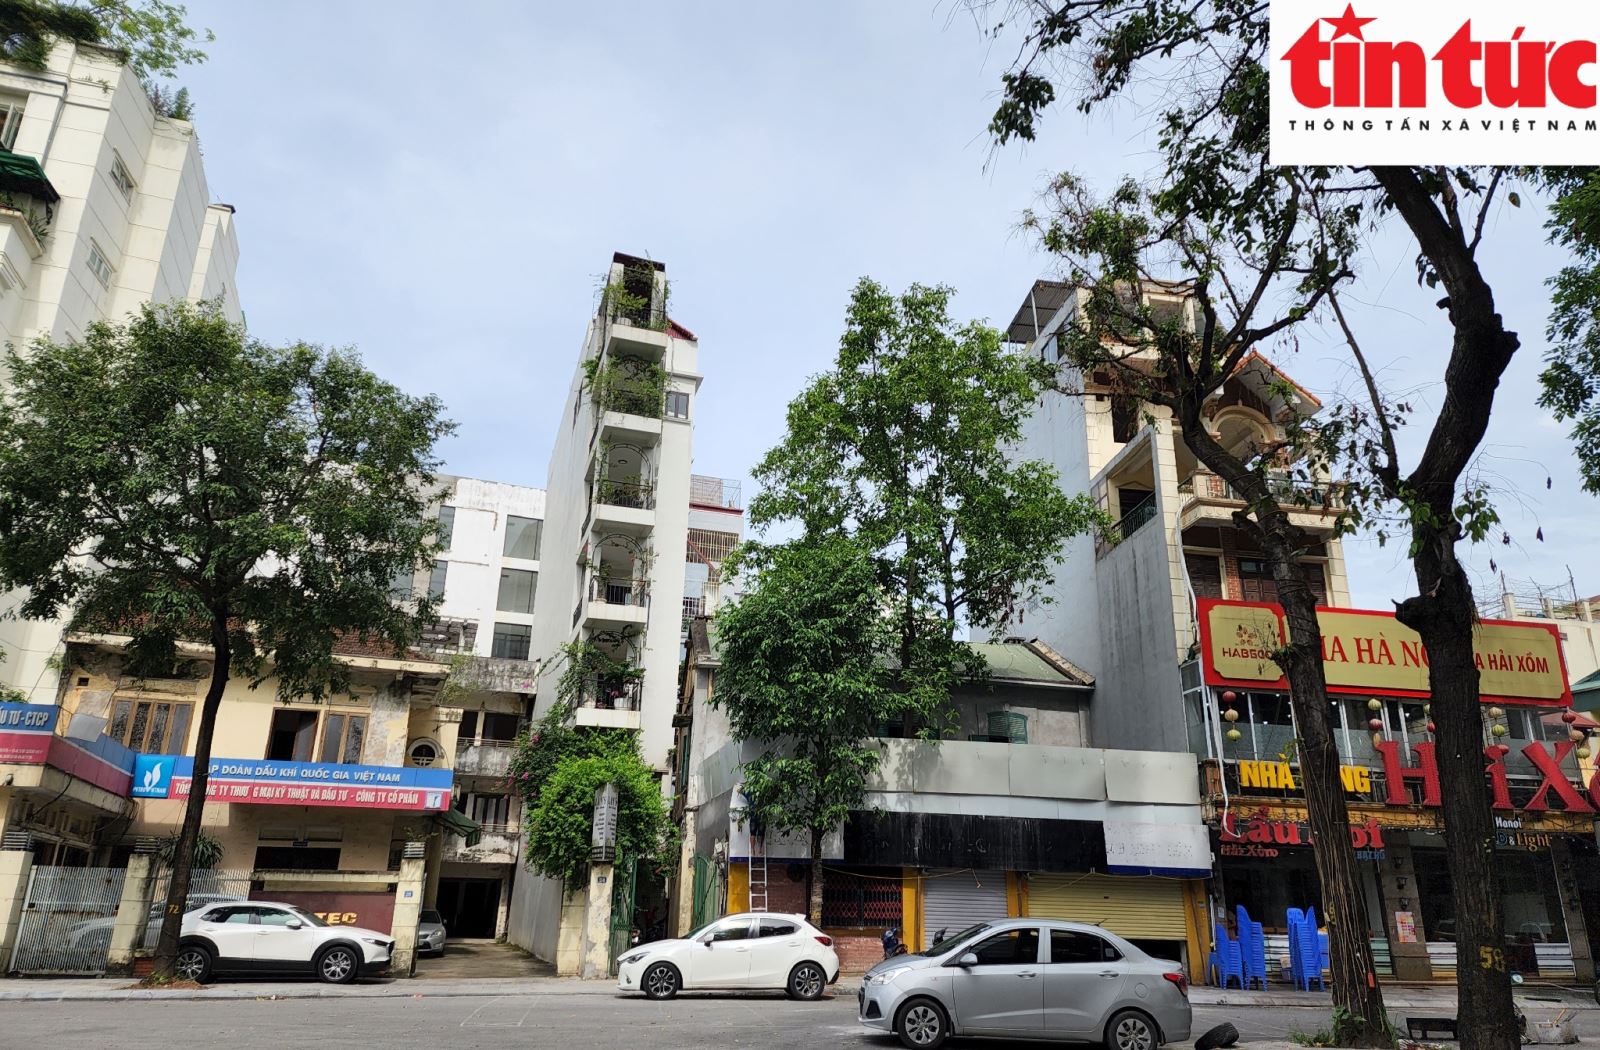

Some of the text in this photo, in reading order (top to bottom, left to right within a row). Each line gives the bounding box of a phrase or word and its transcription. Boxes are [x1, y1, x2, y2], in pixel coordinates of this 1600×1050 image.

[1320, 635, 1349, 662] IA
[1353, 631, 1396, 666] HÀ
[1488, 649, 1513, 672] HẢI
[25, 711, 49, 726] CTCP
[301, 767, 330, 778] QUỐC
[332, 770, 350, 780] GIA
[354, 770, 375, 782] VIỆT
[377, 773, 400, 782] NAM
[1340, 765, 1372, 794] NG
[1495, 816, 1522, 829] Hanoi
[1516, 832, 1550, 852] Light
[314, 912, 358, 924] TEC
